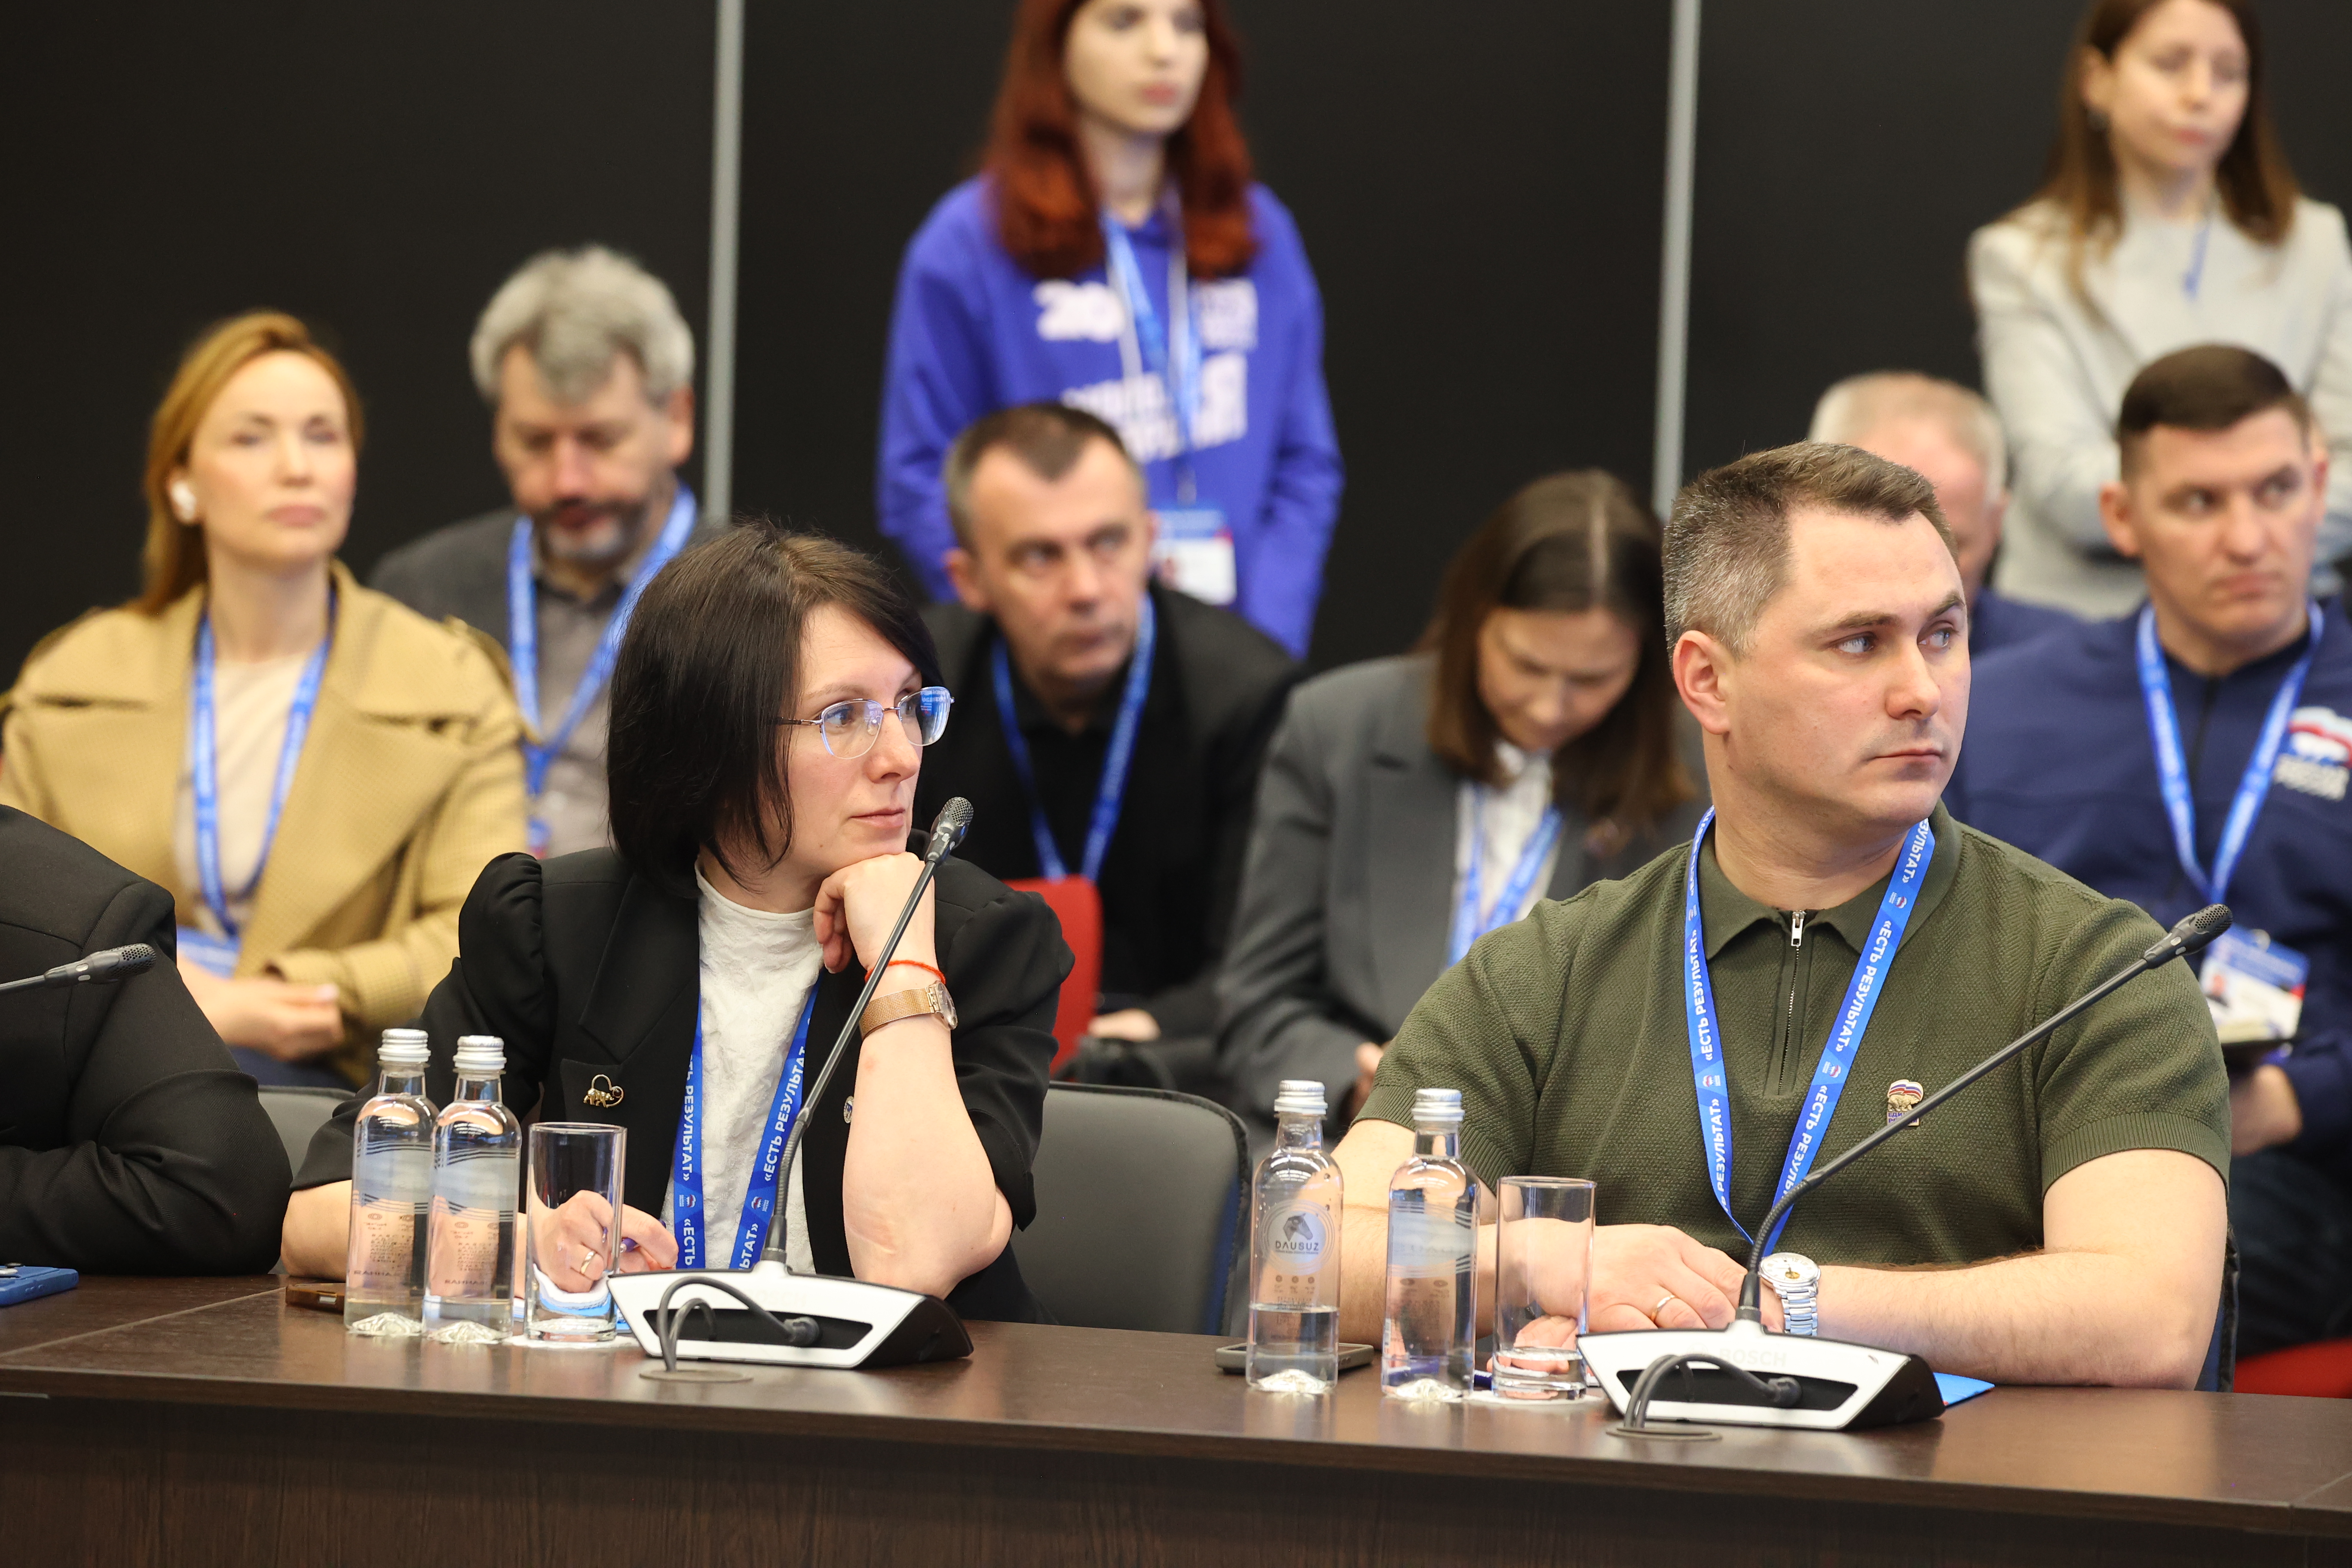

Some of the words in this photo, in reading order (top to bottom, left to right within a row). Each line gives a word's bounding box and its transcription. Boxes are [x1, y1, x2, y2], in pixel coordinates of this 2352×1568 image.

[1869, 920, 1892, 963] «ЕСТЬ
[1690, 929, 1707, 1016] РЕЗУЛЬТАТ»
[1835, 965, 1877, 1052] РЕЗУЛЬТАТ»
[1698, 1017, 1713, 1061] «ЕСТЬ
[1805, 1085, 1828, 1130] «ЕСТЬ
[682, 1085, 694, 1182] РЕЗУЛЬТАТ»
[1709, 1098, 1726, 1192] РЕЗУЛЬТАТ»
[763, 1135, 782, 1182] «ЕСТЬ
[1782, 1132, 1813, 1198] РЕЗУЛЬ
[683, 1218, 696, 1266] «ЕСТЬ
[738, 1223, 759, 1270] ЬТАТ»
[1275, 1240, 1319, 1251] DAUSUZ
[1720, 1348, 1788, 1367] BOSCH
